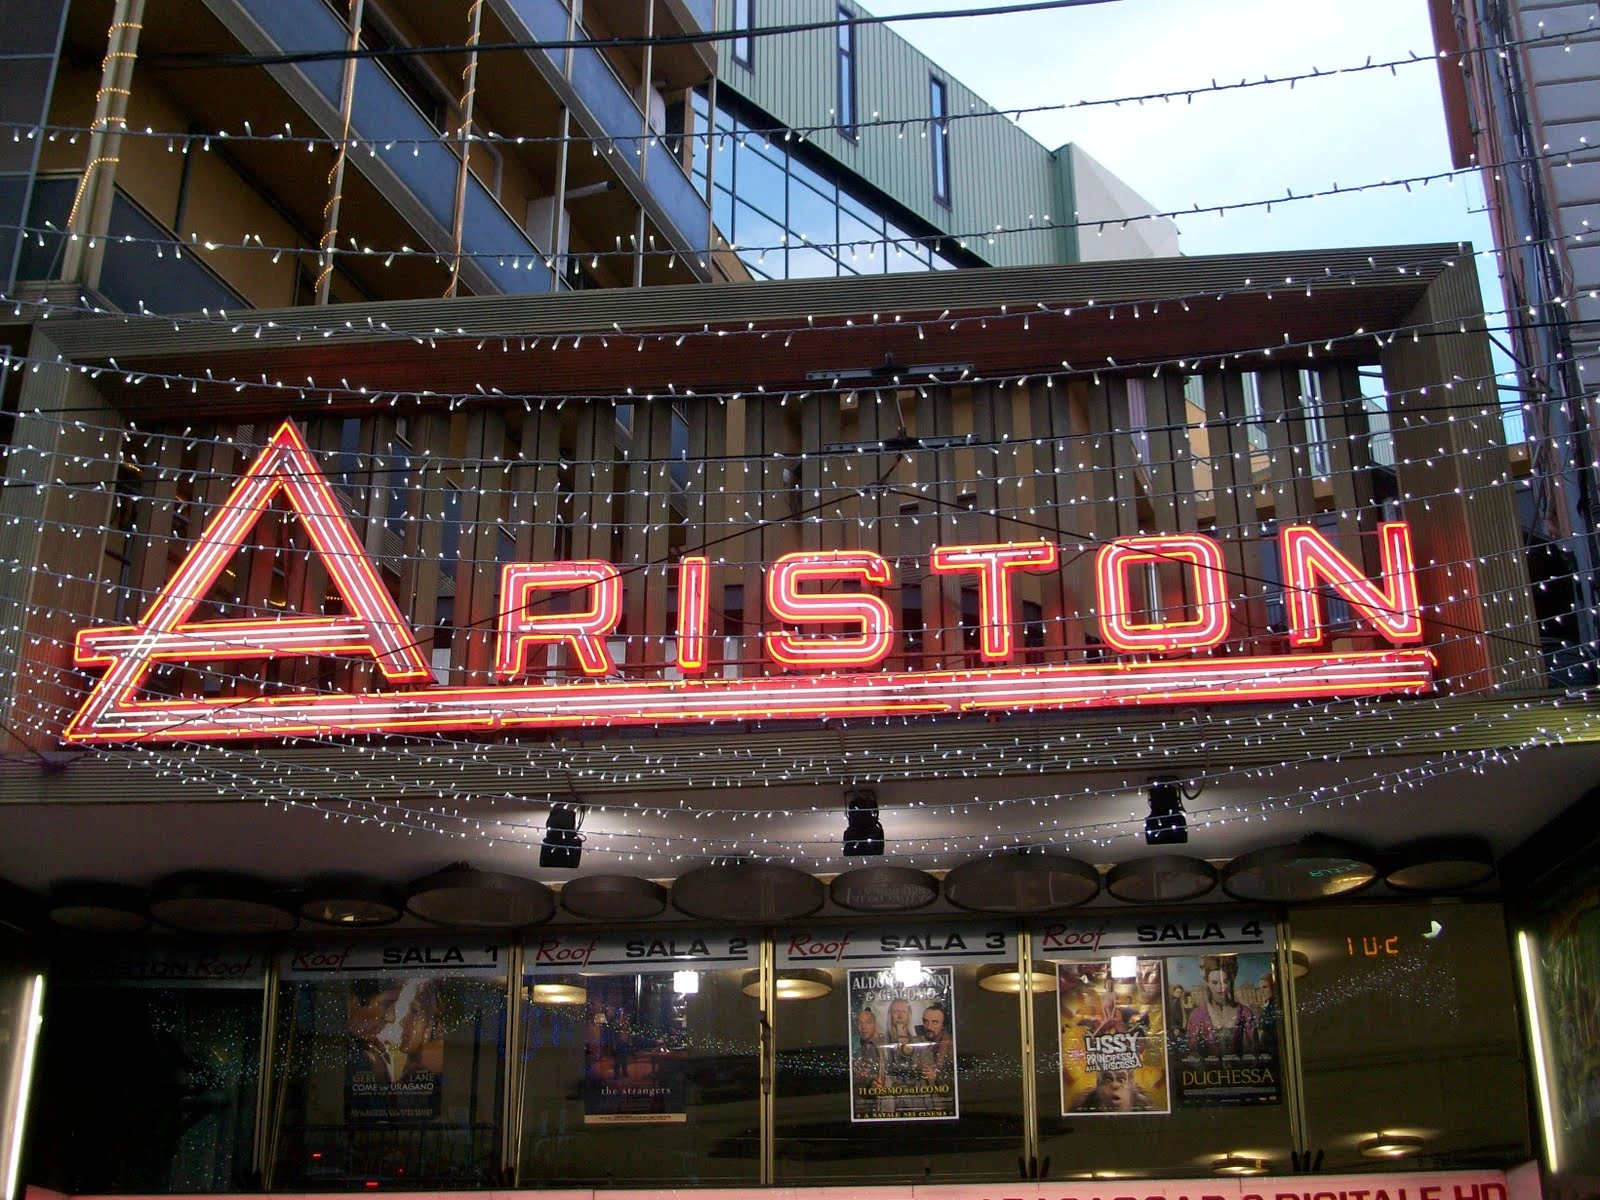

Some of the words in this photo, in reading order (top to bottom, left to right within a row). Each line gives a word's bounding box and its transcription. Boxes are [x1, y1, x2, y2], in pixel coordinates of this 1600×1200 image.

[62, 417, 1424, 746] ARISTON
[787, 931, 855, 962] Roof
[880, 933, 967, 952] SALA
[985, 931, 1005, 949] 3
[1042, 922, 1106, 953] Roof
[1137, 921, 1226, 942] SALA
[1241, 920, 1262, 938] 4
[291, 943, 350, 973] Roof
[382, 945, 465, 964] SALA
[485, 945, 498, 962] 1
[535, 939, 597, 968] Roof
[626, 938, 710, 958] SALA
[728, 937, 749, 955] 2
[1085, 1032, 1139, 1053] LISSY
[352, 1083, 378, 1092] COME
[390, 1082, 434, 1091] URAGANO
[601, 1086, 618, 1096] the
[622, 1087, 671, 1098] strangers
[1182, 1068, 1275, 1086] DUCHESSA
